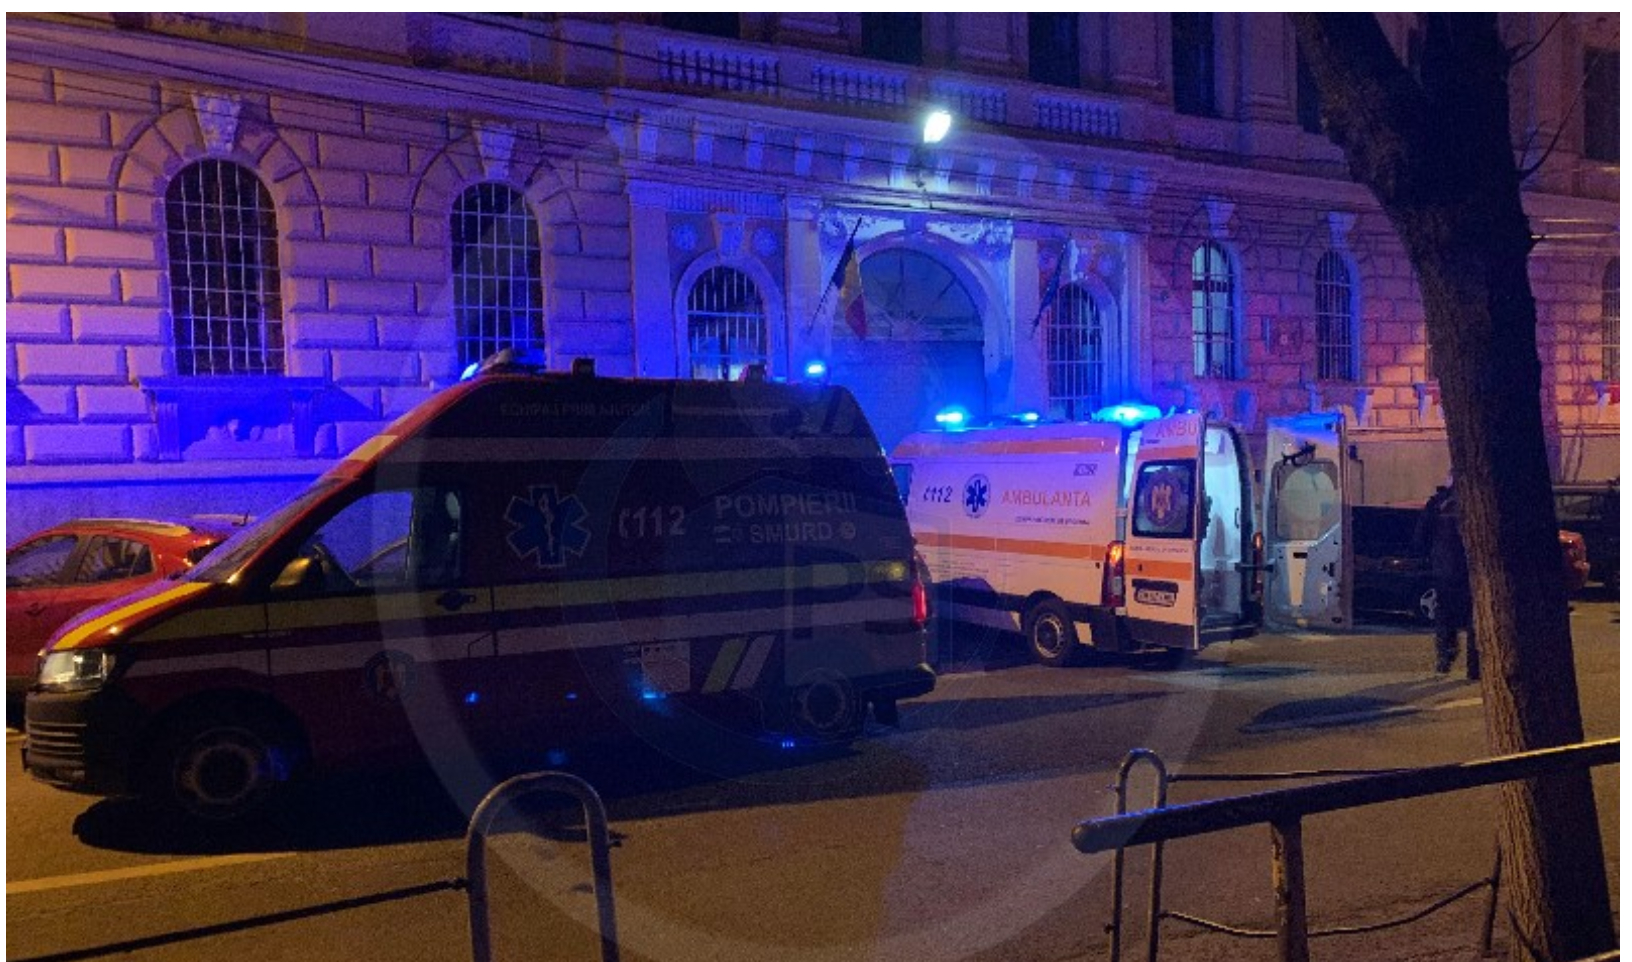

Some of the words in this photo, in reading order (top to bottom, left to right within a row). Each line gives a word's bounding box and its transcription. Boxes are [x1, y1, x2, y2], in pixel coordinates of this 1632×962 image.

[714, 492, 857, 520] POMPIERII
[1000, 489, 1092, 507] AMBULANTA
[632, 504, 686, 539] 112
[748, 521, 832, 544] SMURD
